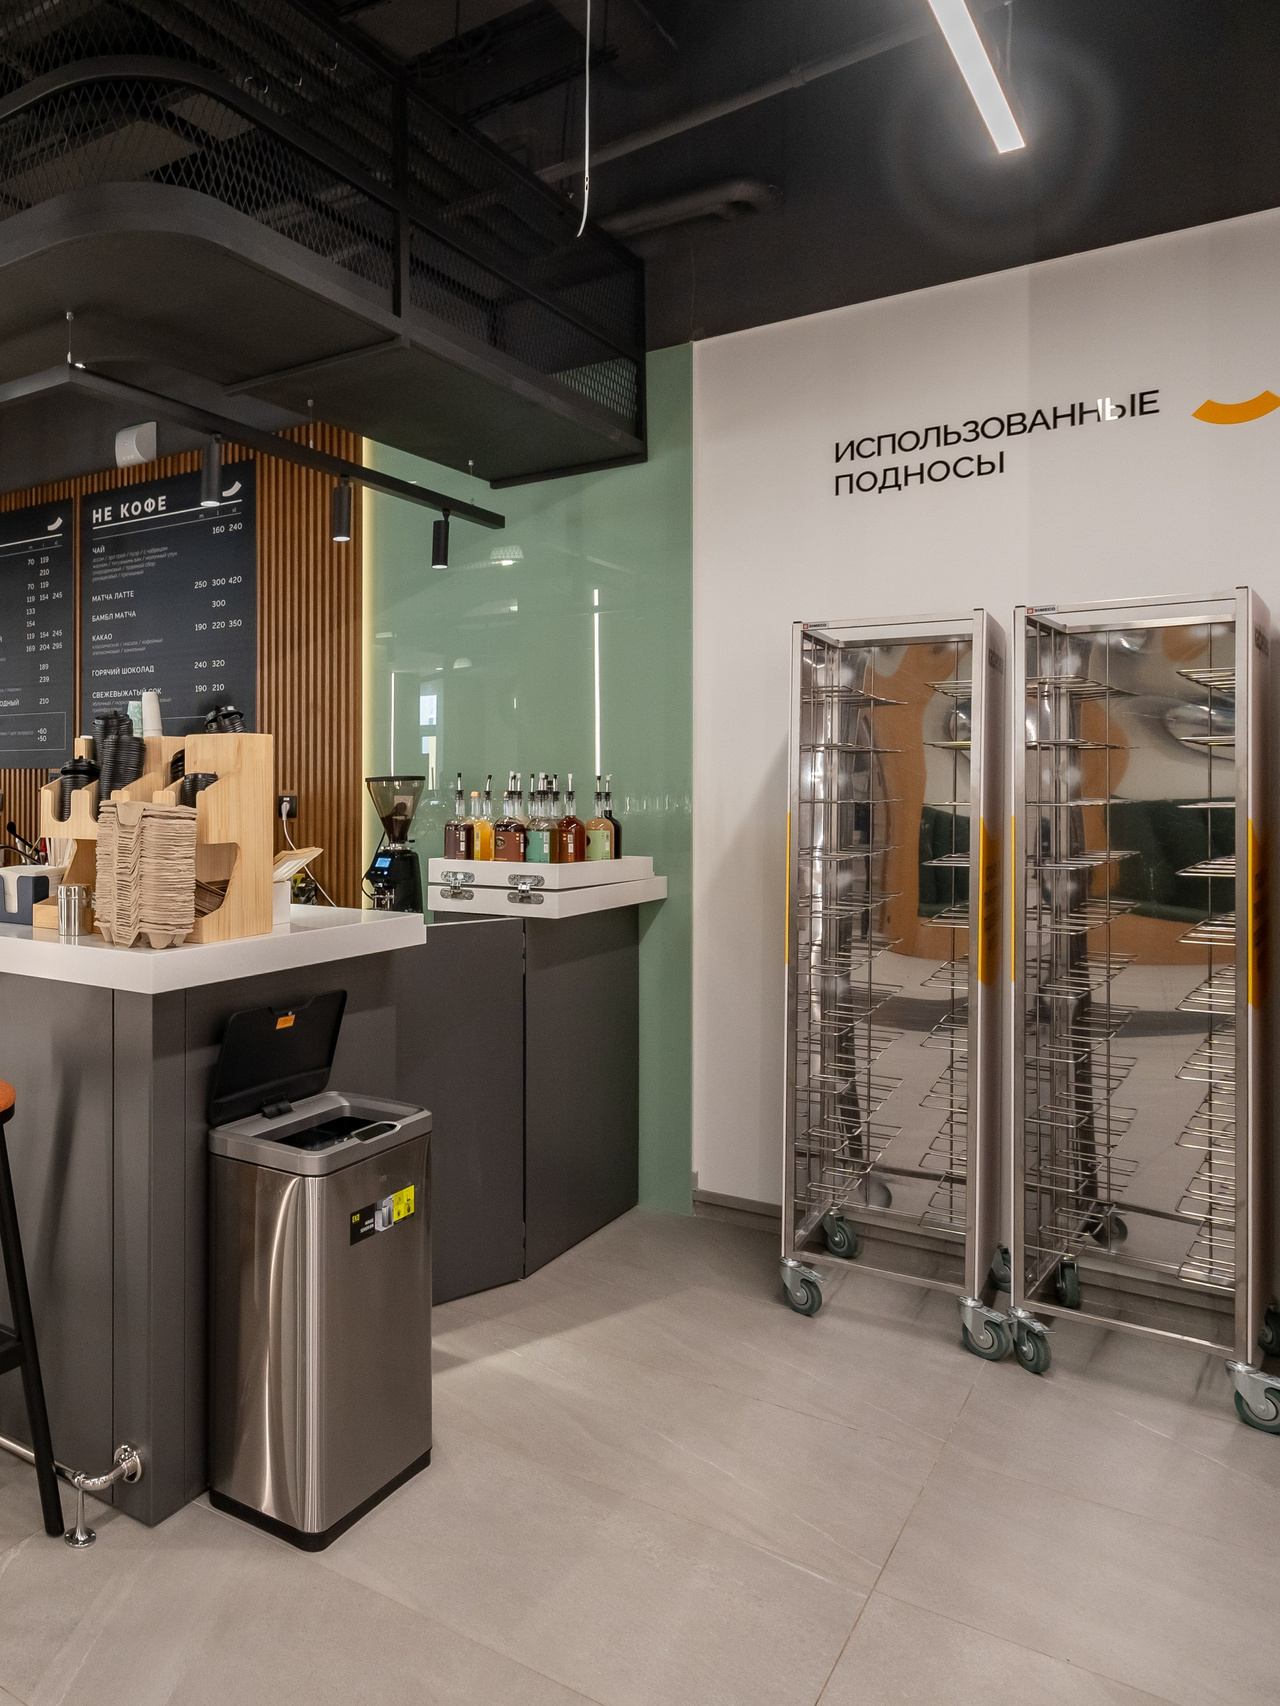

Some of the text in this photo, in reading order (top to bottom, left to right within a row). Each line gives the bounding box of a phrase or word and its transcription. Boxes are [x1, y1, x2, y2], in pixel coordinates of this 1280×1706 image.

[834, 389, 1160, 464] ИСПОЛЬЗОВАННЫЕ
[834, 450, 1005, 496] ПОДНОСЫ
[92, 496, 166, 523] НЕ КОФЕ
[92, 523, 242, 554] ЧАЙ 160 240
[40, 556, 49, 564] 119
[92, 576, 242, 602] МАТЧА ЛАТТЕ 250 300 420
[92, 600, 226, 622] БАМБЛ МАТЧА 300
[40, 631, 49, 639] 154
[92, 620, 242, 641] КАКАО 190 220 350
[92, 667, 120, 677] ГОРЯЧИЙ
[122, 666, 154, 675] ШОКОЛАД
[194, 661, 207, 669] 240
[212, 684, 225, 692] 210
